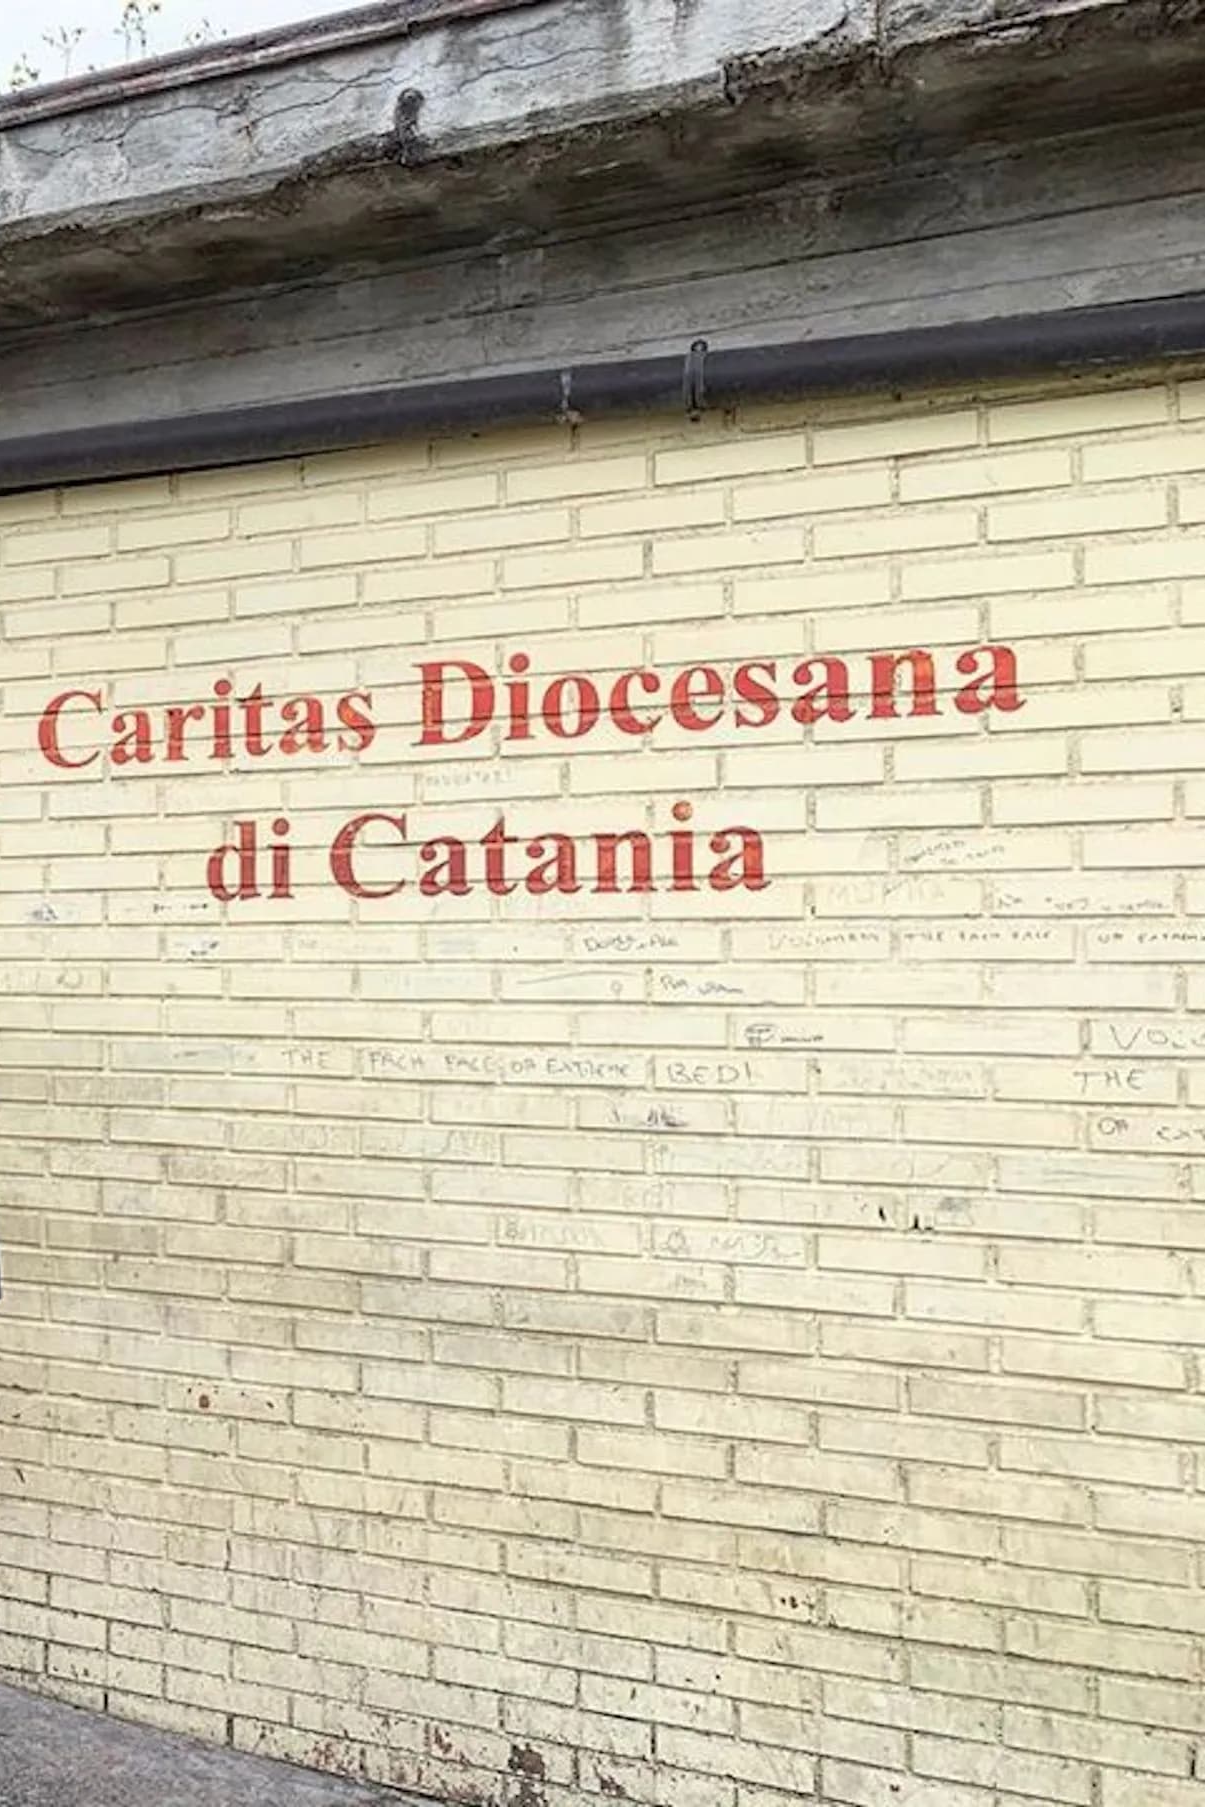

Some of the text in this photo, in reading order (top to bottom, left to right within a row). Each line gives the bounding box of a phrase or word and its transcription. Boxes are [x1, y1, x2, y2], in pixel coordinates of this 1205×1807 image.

[36, 643, 1026, 771] Caritas Diocesana
[205, 802, 771, 902] di Catania
